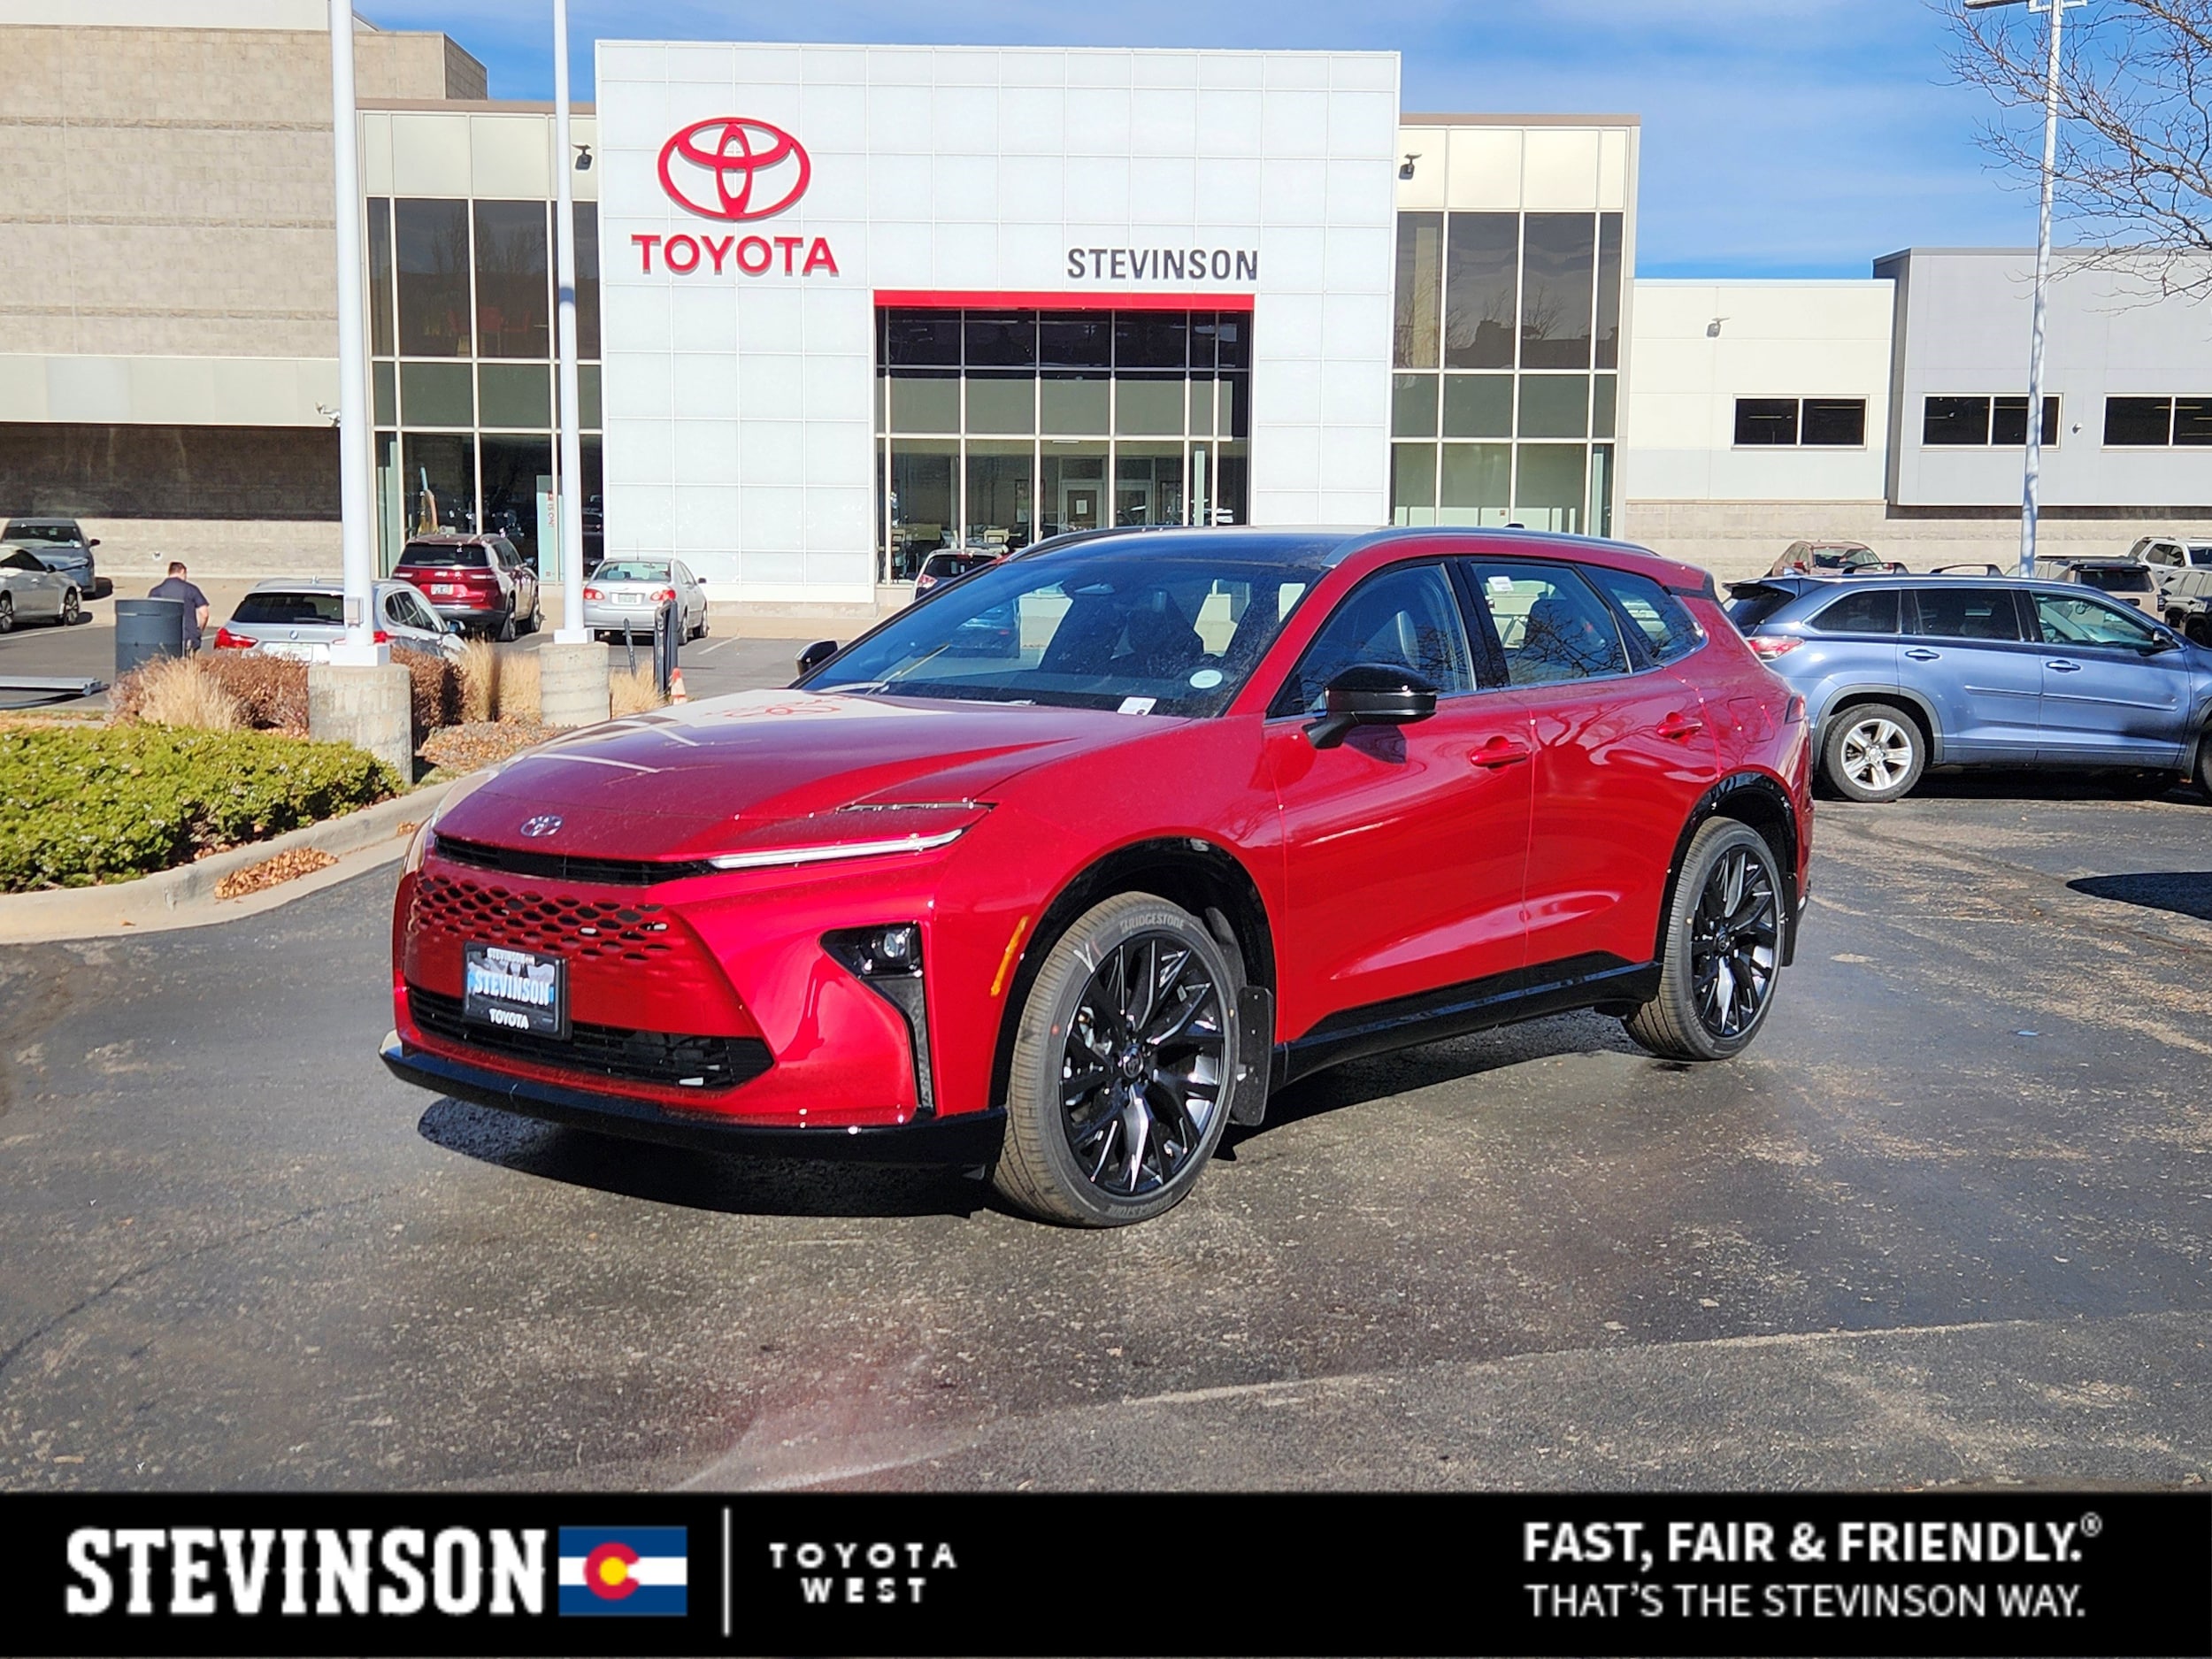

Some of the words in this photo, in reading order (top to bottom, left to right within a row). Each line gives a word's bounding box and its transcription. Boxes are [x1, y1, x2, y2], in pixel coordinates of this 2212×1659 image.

[631, 234, 839, 276] TOYOTA
[1067, 248, 1257, 280] STEVINSON
[1119, 912, 1184, 935] BRIDGESTONE
[474, 971, 549, 1006] STEVINSON
[488, 1008, 529, 1030] TOYOTA
